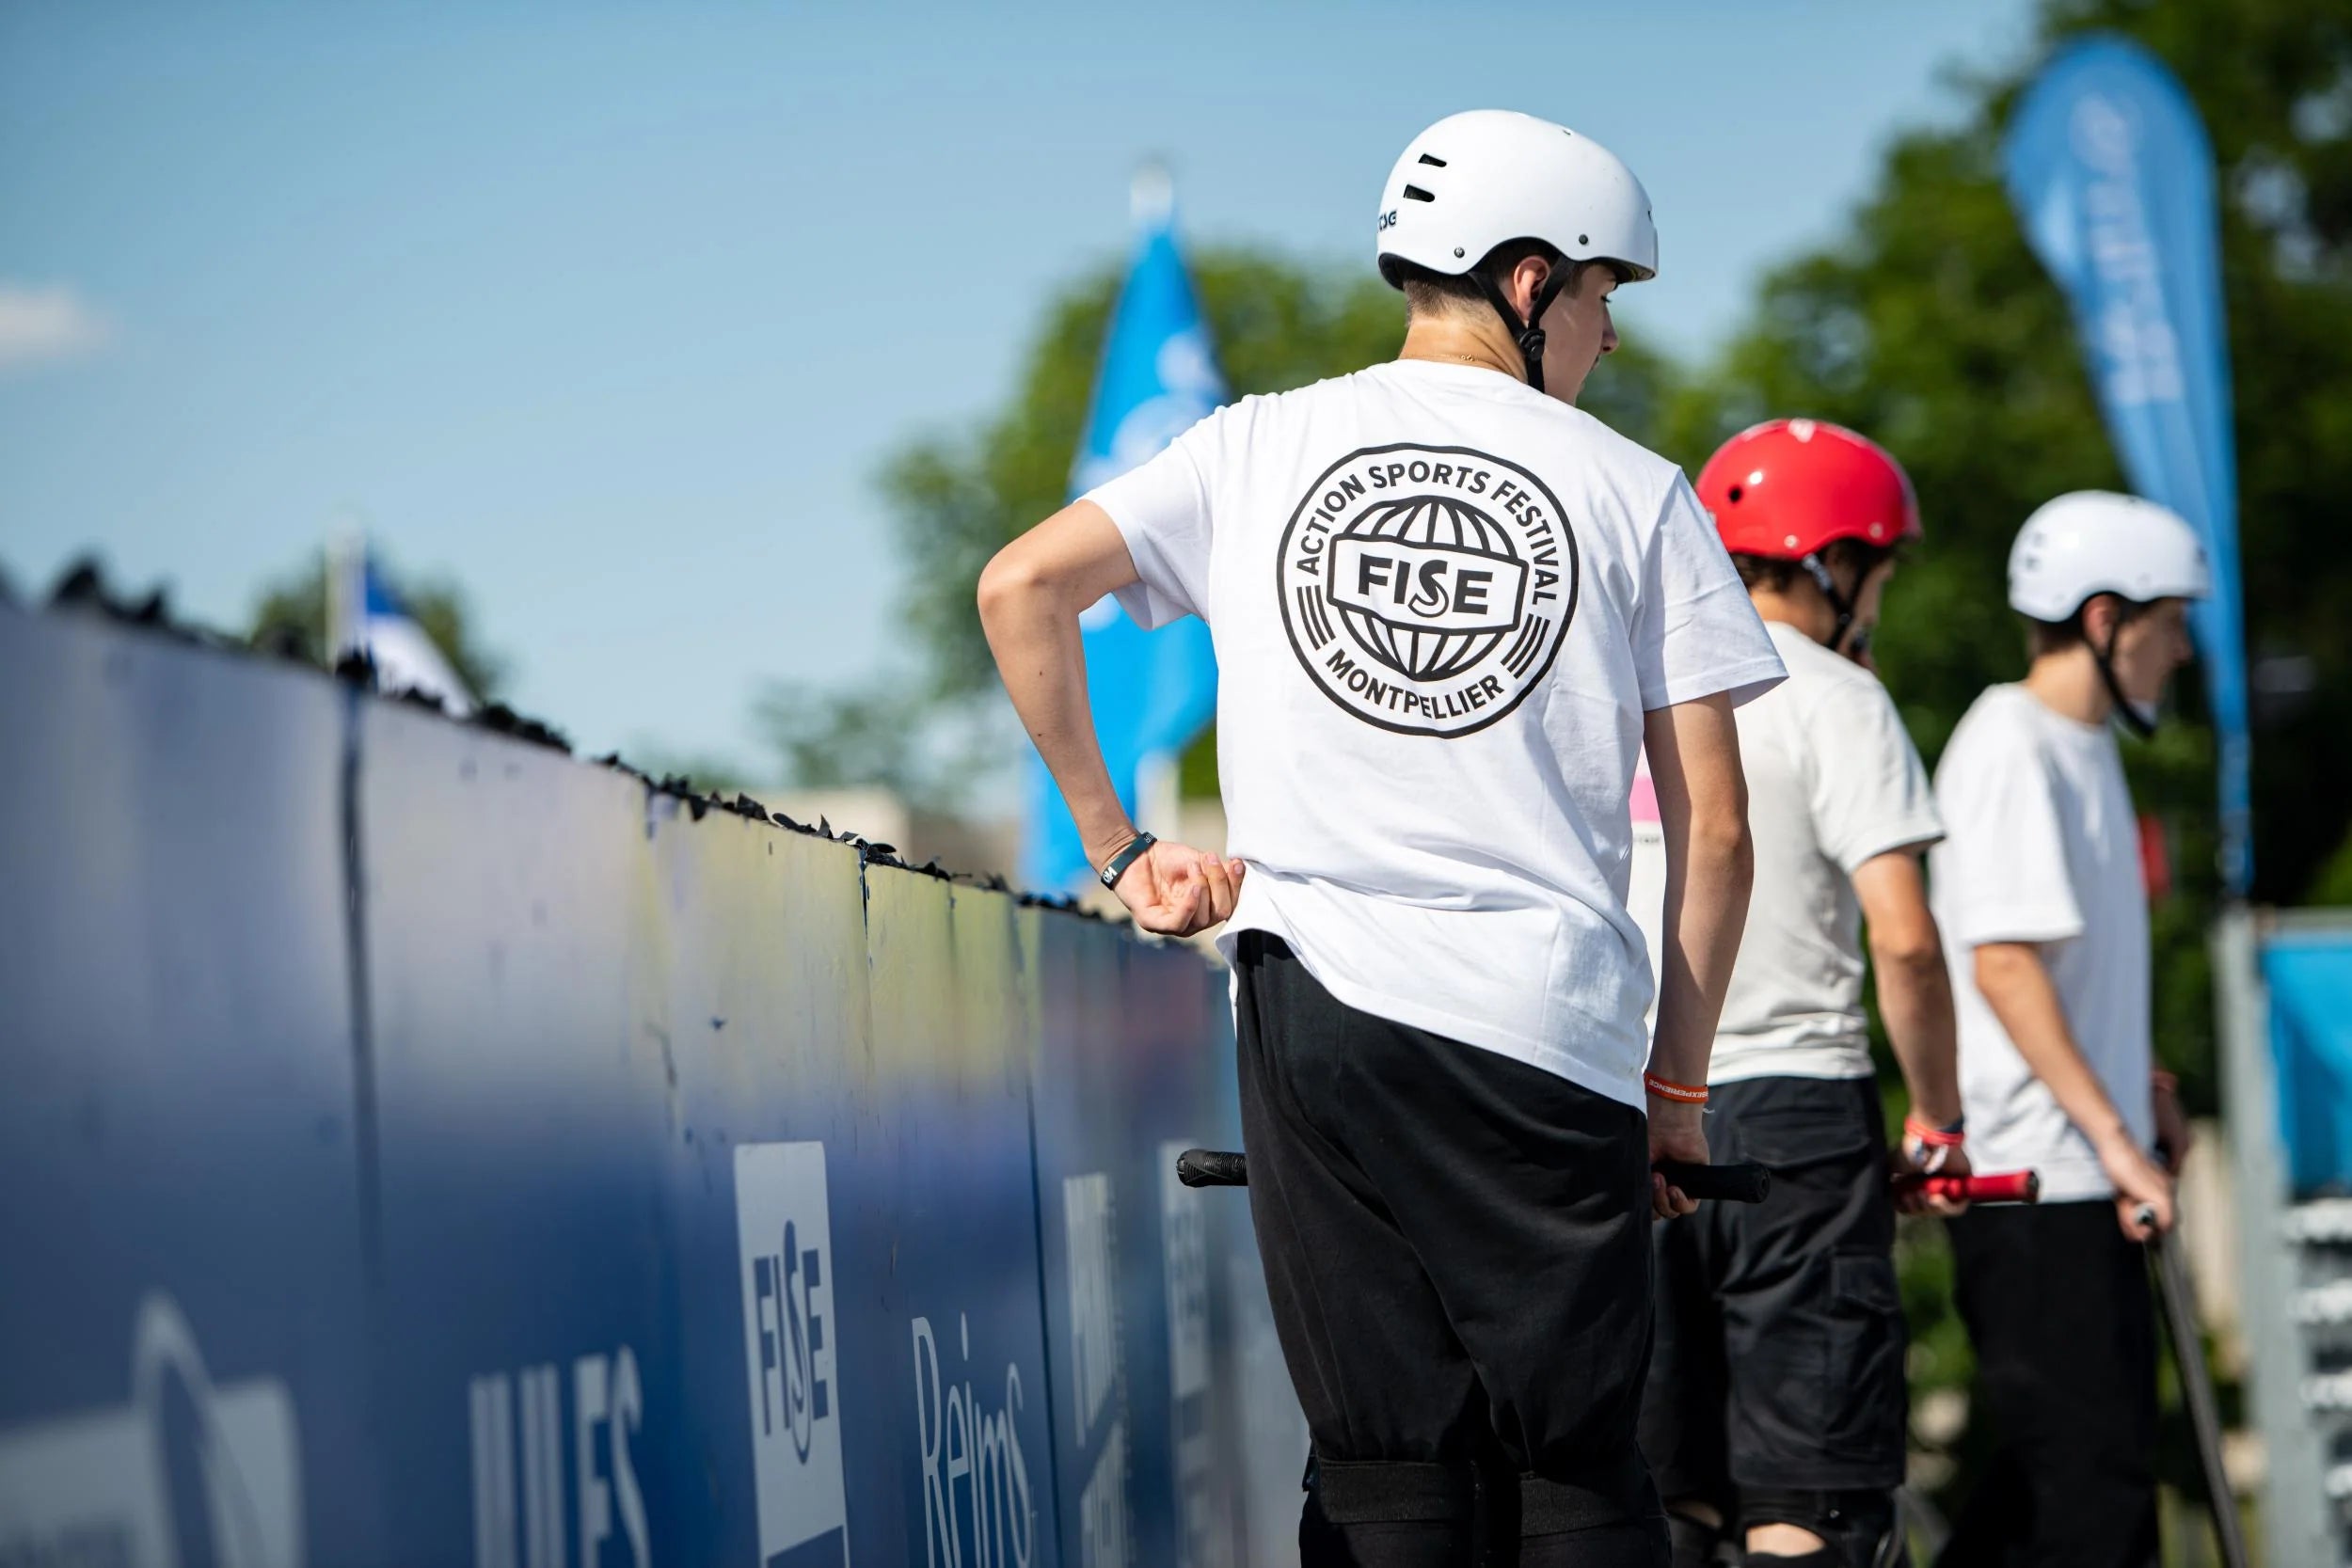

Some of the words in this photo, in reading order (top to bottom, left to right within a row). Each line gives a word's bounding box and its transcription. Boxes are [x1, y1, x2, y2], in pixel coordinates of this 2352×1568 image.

[1296, 474, 1366, 576] ACTION
[1368, 461, 1490, 494] SPORTS
[1490, 479, 1560, 605] FESTIVAL
[1358, 553, 1493, 618] FISE
[1325, 648, 1505, 720] MONTPELLIER
[754, 1220, 829, 1465] FISE
[912, 1311, 1032, 1568] Reims
